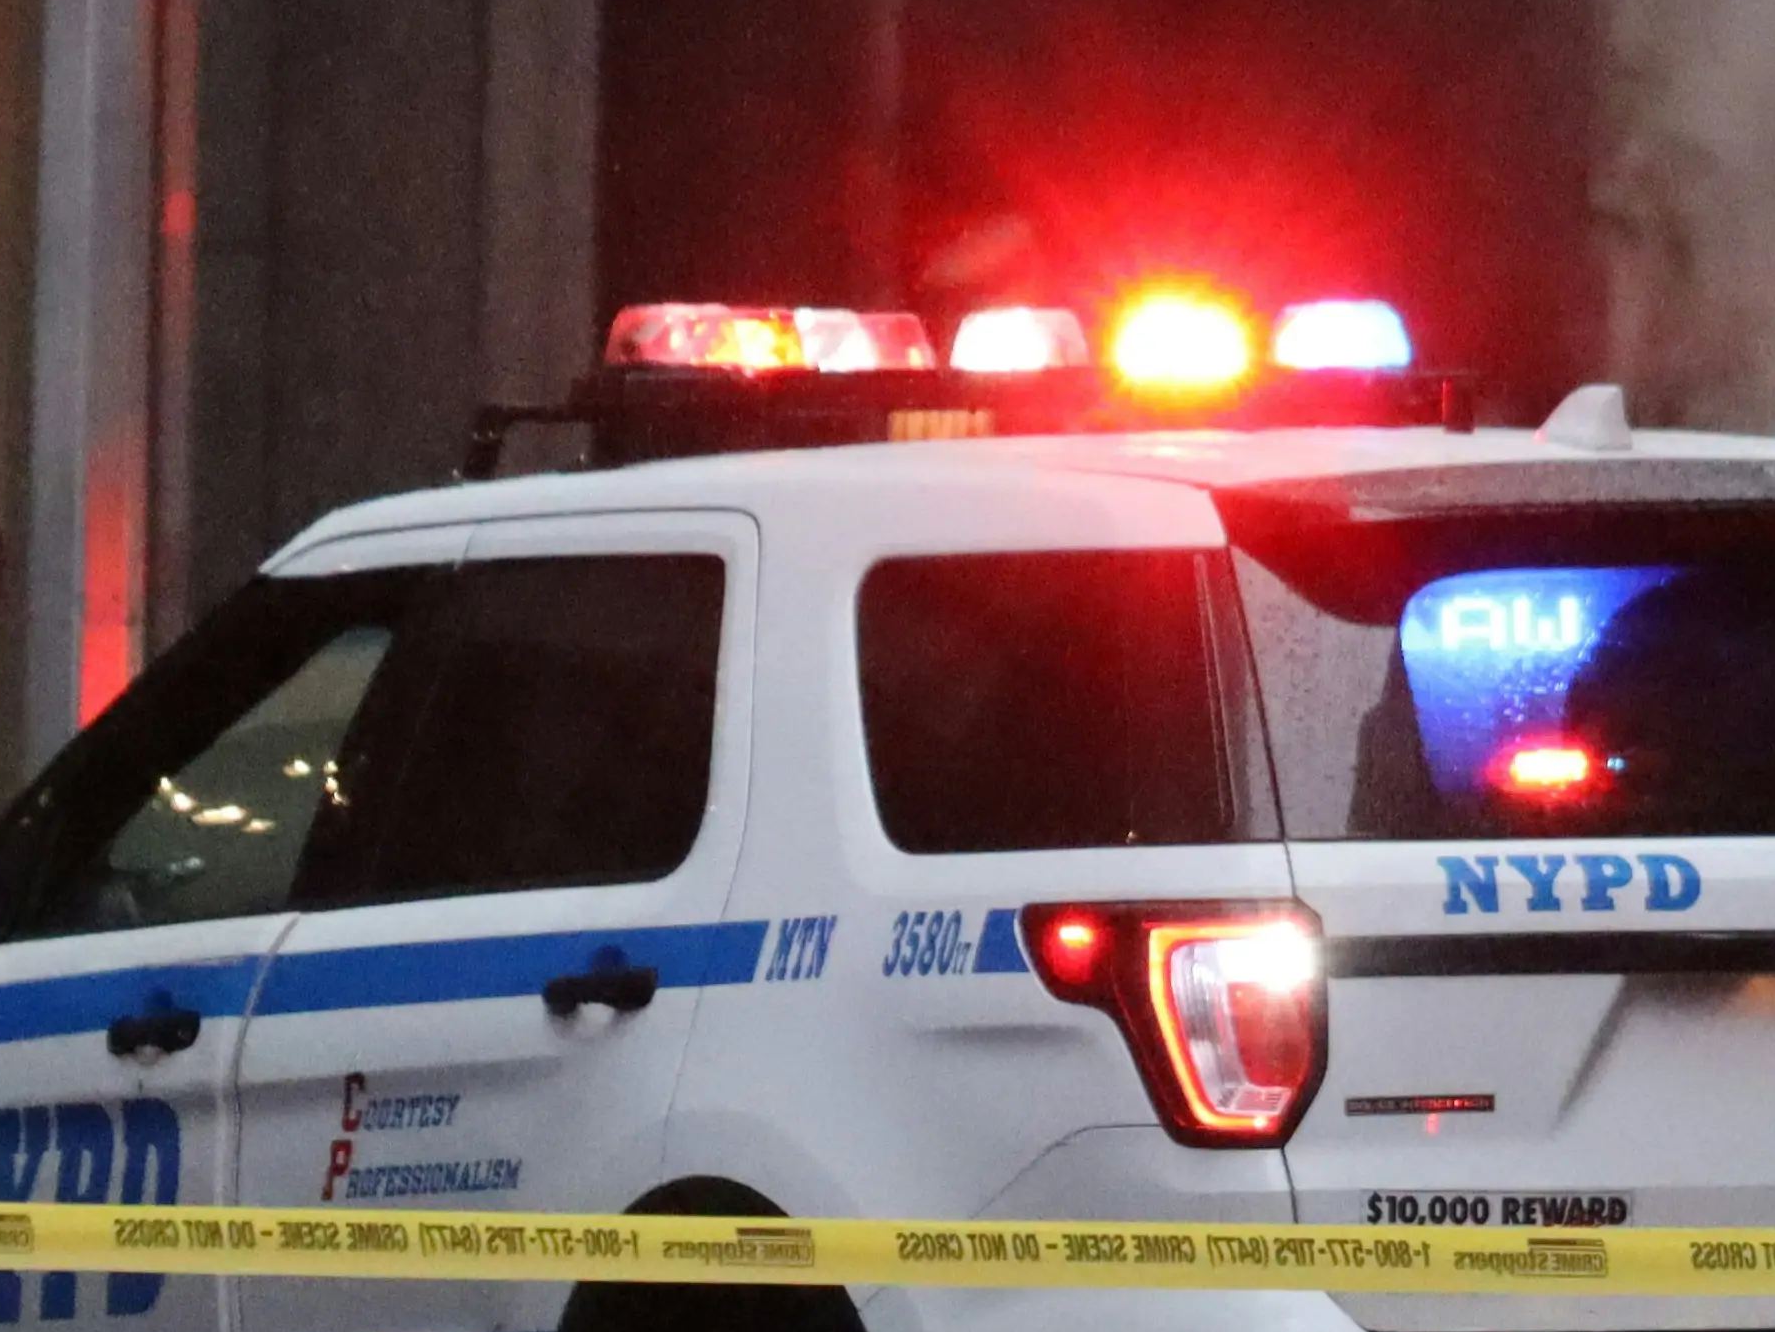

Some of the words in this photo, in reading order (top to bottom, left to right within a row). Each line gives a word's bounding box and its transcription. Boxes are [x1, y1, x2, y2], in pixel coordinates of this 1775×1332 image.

[1437, 854, 1701, 914] NYPD
[342, 1071, 461, 1132] COURTESY
[321, 1139, 522, 1200] PROFESSIONALISM
[1367, 1191, 1489, 1227] $10,000
[1501, 1193, 1627, 1227] REWARD
